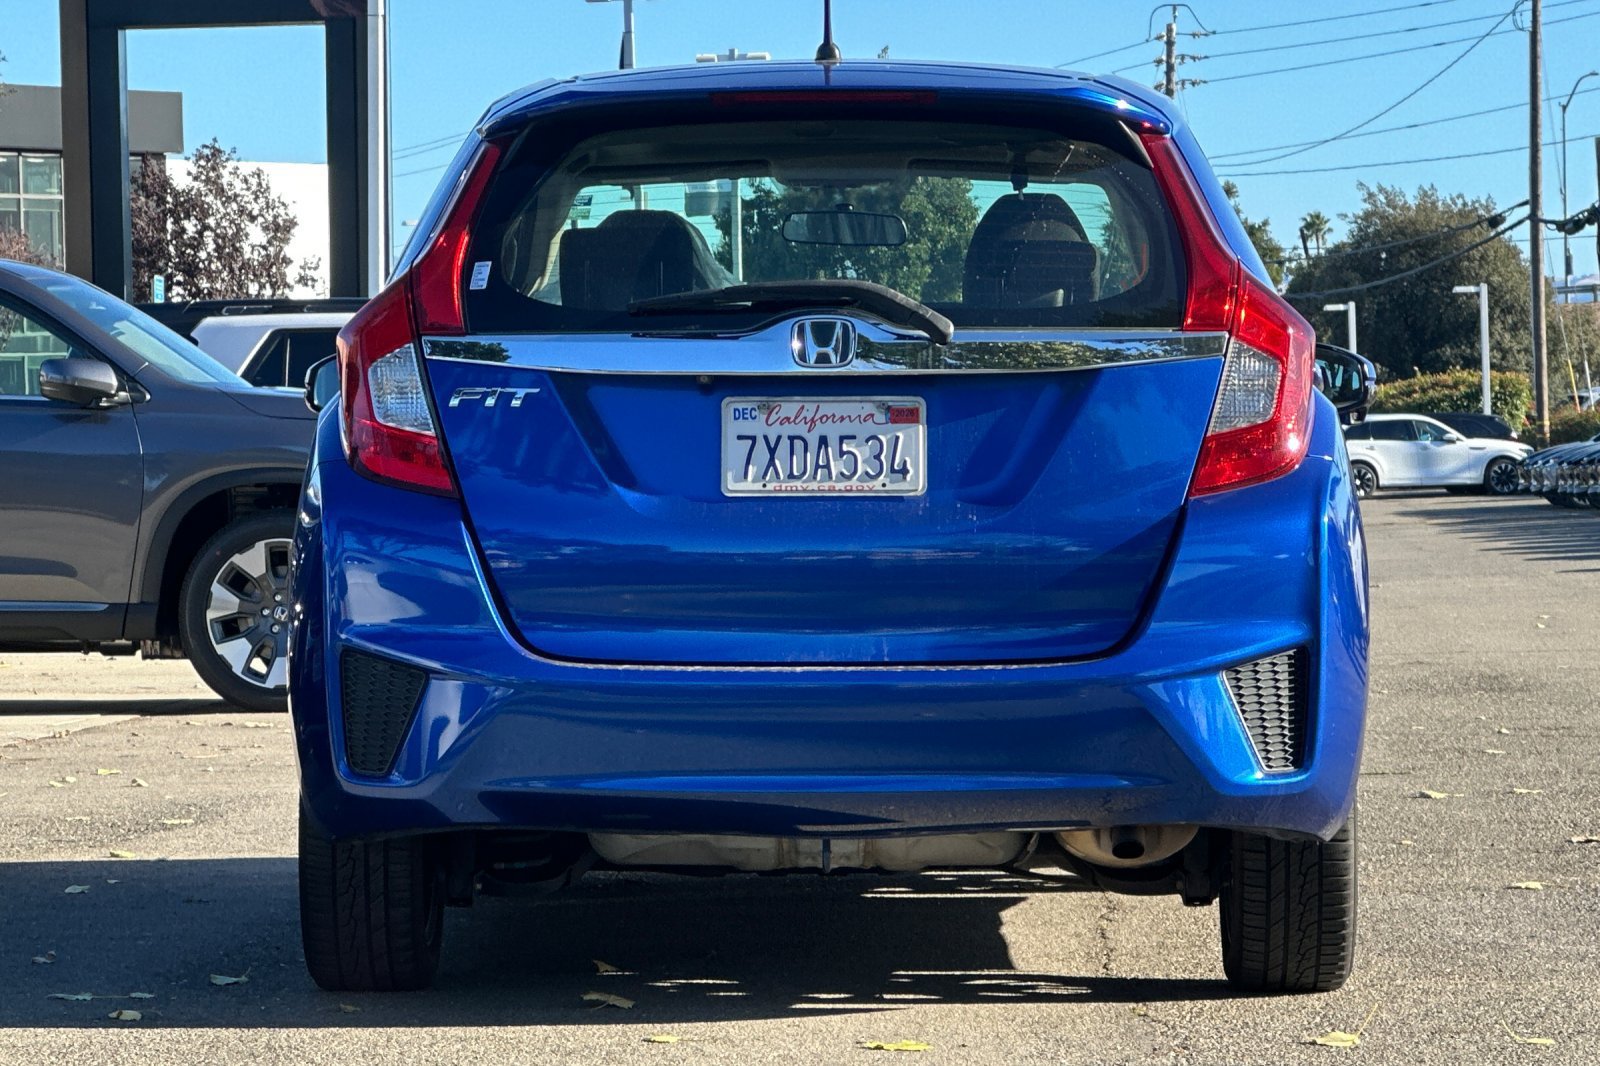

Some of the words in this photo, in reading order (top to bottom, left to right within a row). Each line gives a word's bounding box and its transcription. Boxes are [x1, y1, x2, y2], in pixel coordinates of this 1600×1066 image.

[448, 387, 541, 407] FIT
[733, 407, 758, 421] DEC
[764, 403, 889, 433] California
[736, 434, 911, 481] 7XDA534
[773, 483, 876, 492] dmv.ca.gov
